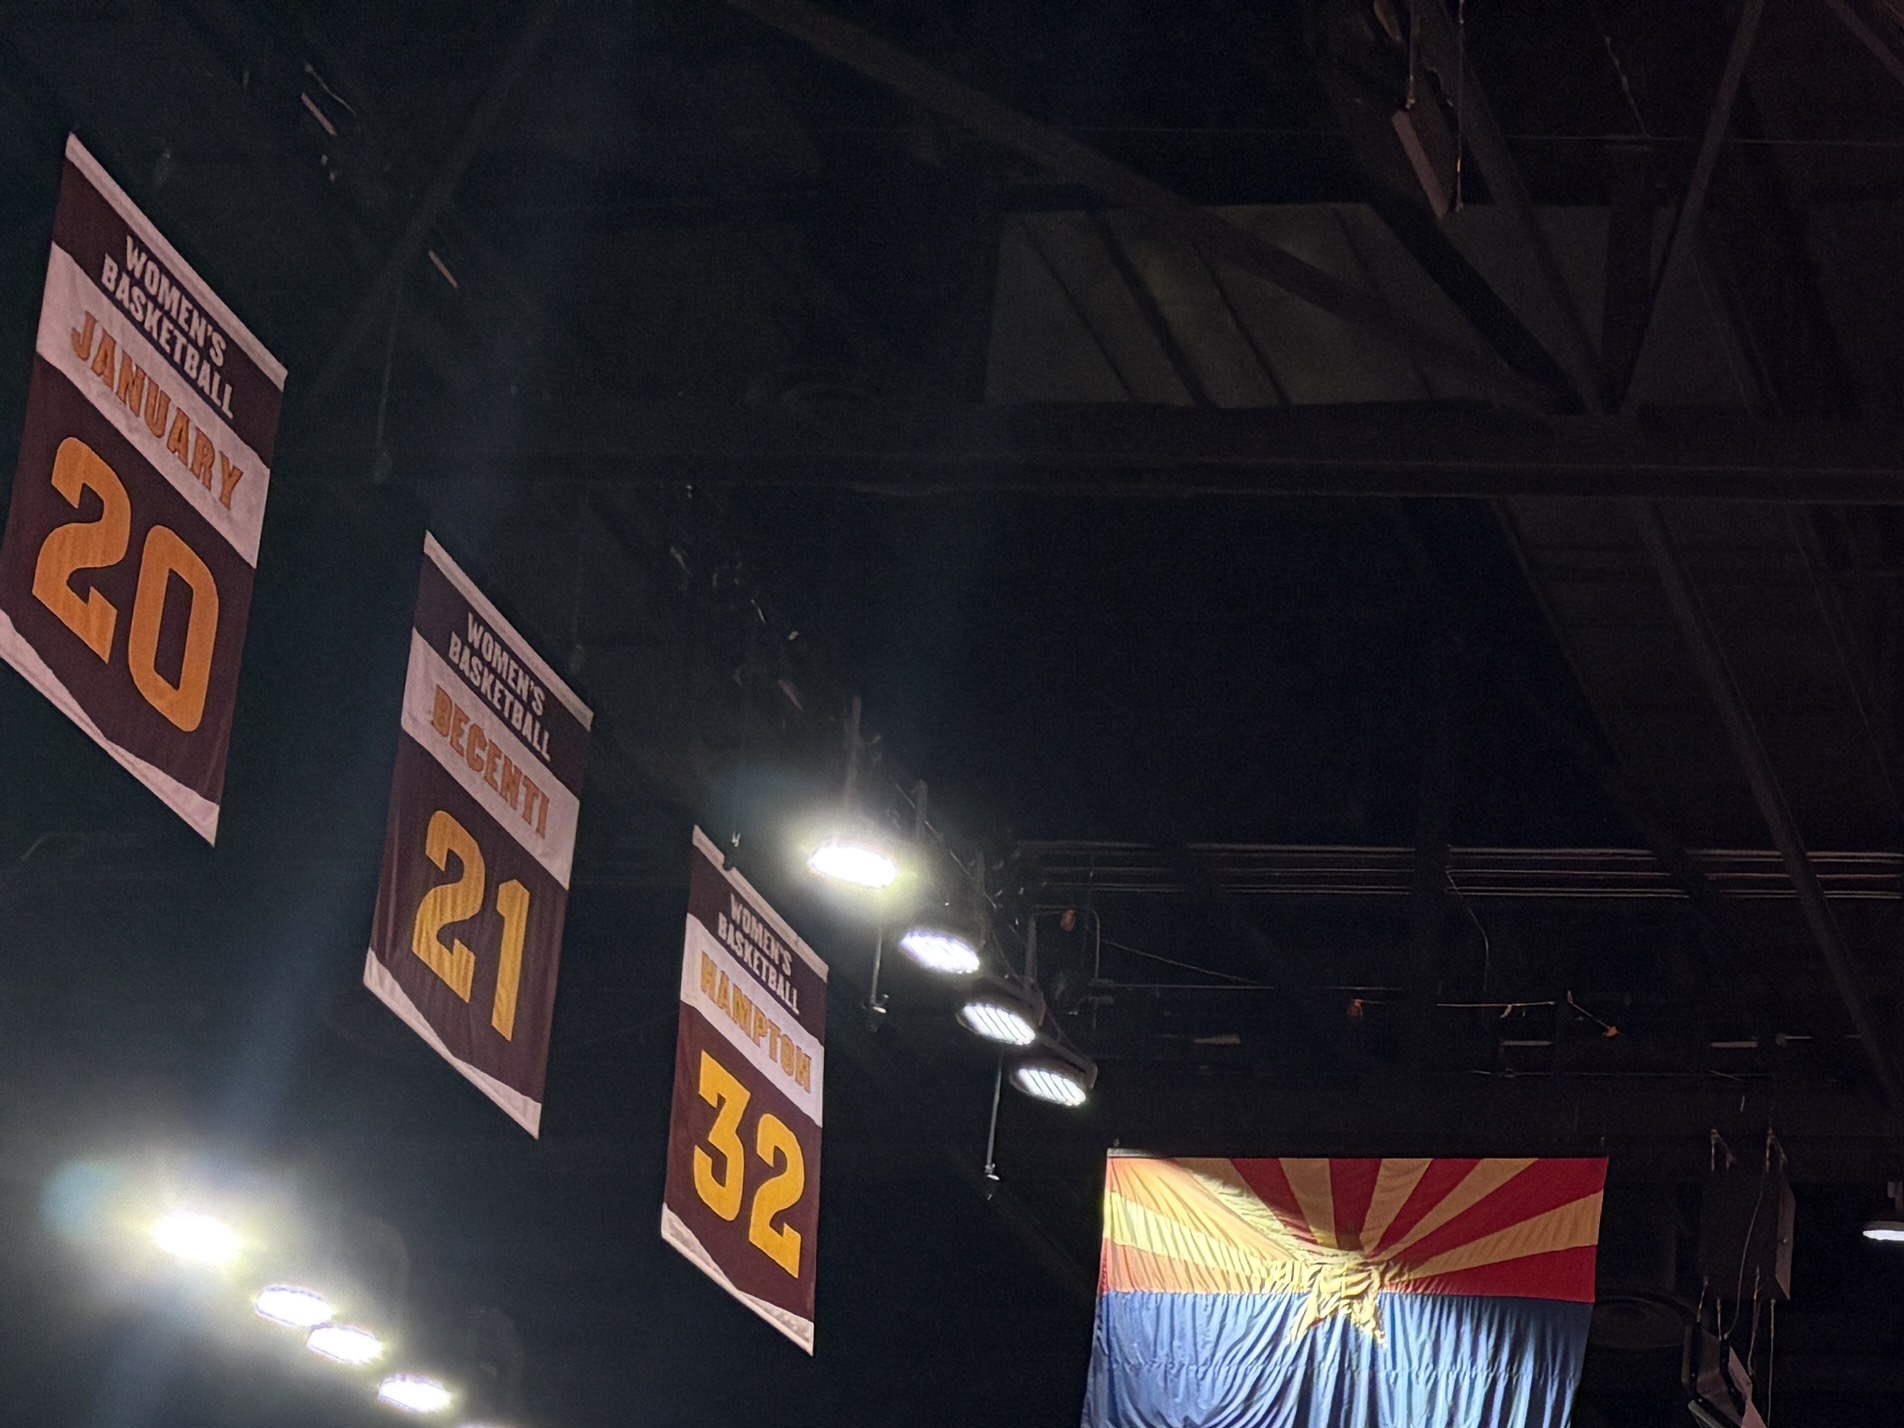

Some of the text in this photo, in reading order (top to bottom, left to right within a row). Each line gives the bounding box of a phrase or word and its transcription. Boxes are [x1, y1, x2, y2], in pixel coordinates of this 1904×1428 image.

[102, 253, 235, 420] BASKETBALL
[125, 235, 227, 369] WOMEN'S
[71, 312, 245, 513] JANUARY
[32, 436, 220, 733] 20
[449, 631, 551, 762] BASKETBALL
[467, 612, 545, 716] WOMEN'S
[412, 810, 530, 1041] 21
[718, 913, 800, 1014] BASKETBALL
[730, 893, 792, 976] WOMEN'S
[701, 951, 812, 1094] HAMPTON
[694, 1050, 805, 1278] 32
